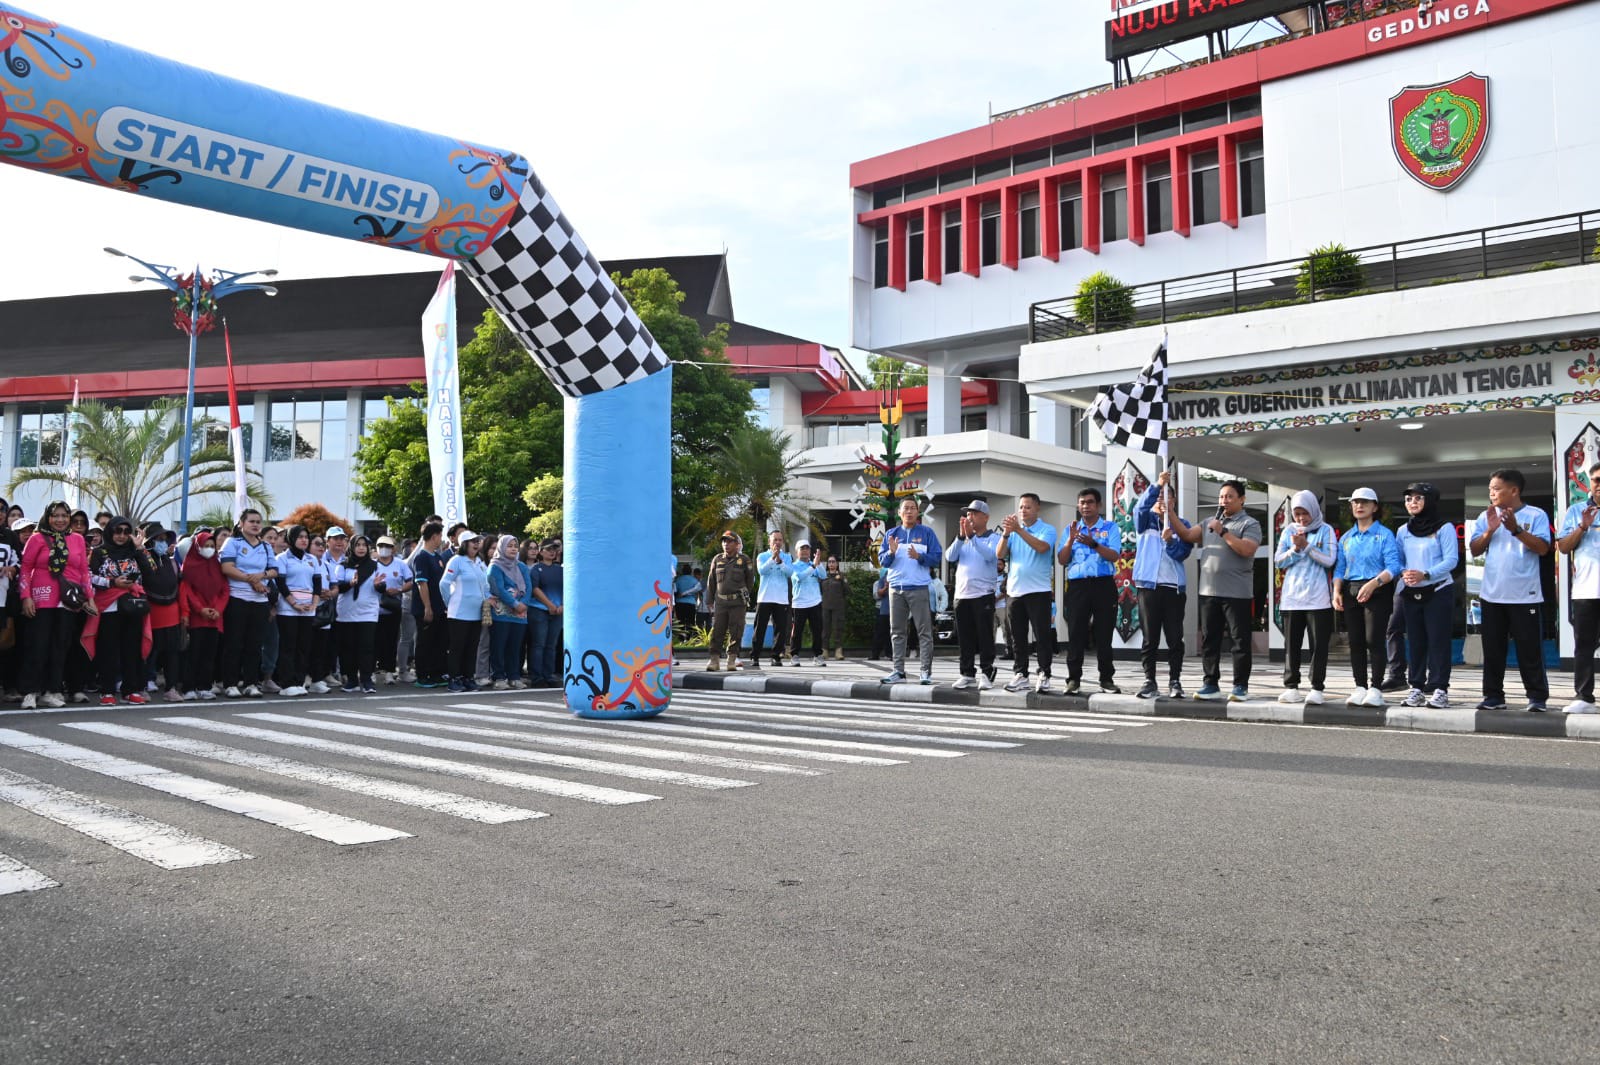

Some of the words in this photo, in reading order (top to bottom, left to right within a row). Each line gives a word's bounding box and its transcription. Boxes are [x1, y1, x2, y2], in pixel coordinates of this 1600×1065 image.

[113, 118, 264, 181] START
[298, 164, 429, 220] FINISH
[1168, 397, 1220, 421] ANTOR
[1225, 386, 1324, 416] GUBERNUR
[1329, 371, 1457, 407] KALIMANTAN
[1462, 361, 1552, 393] TENGAH
